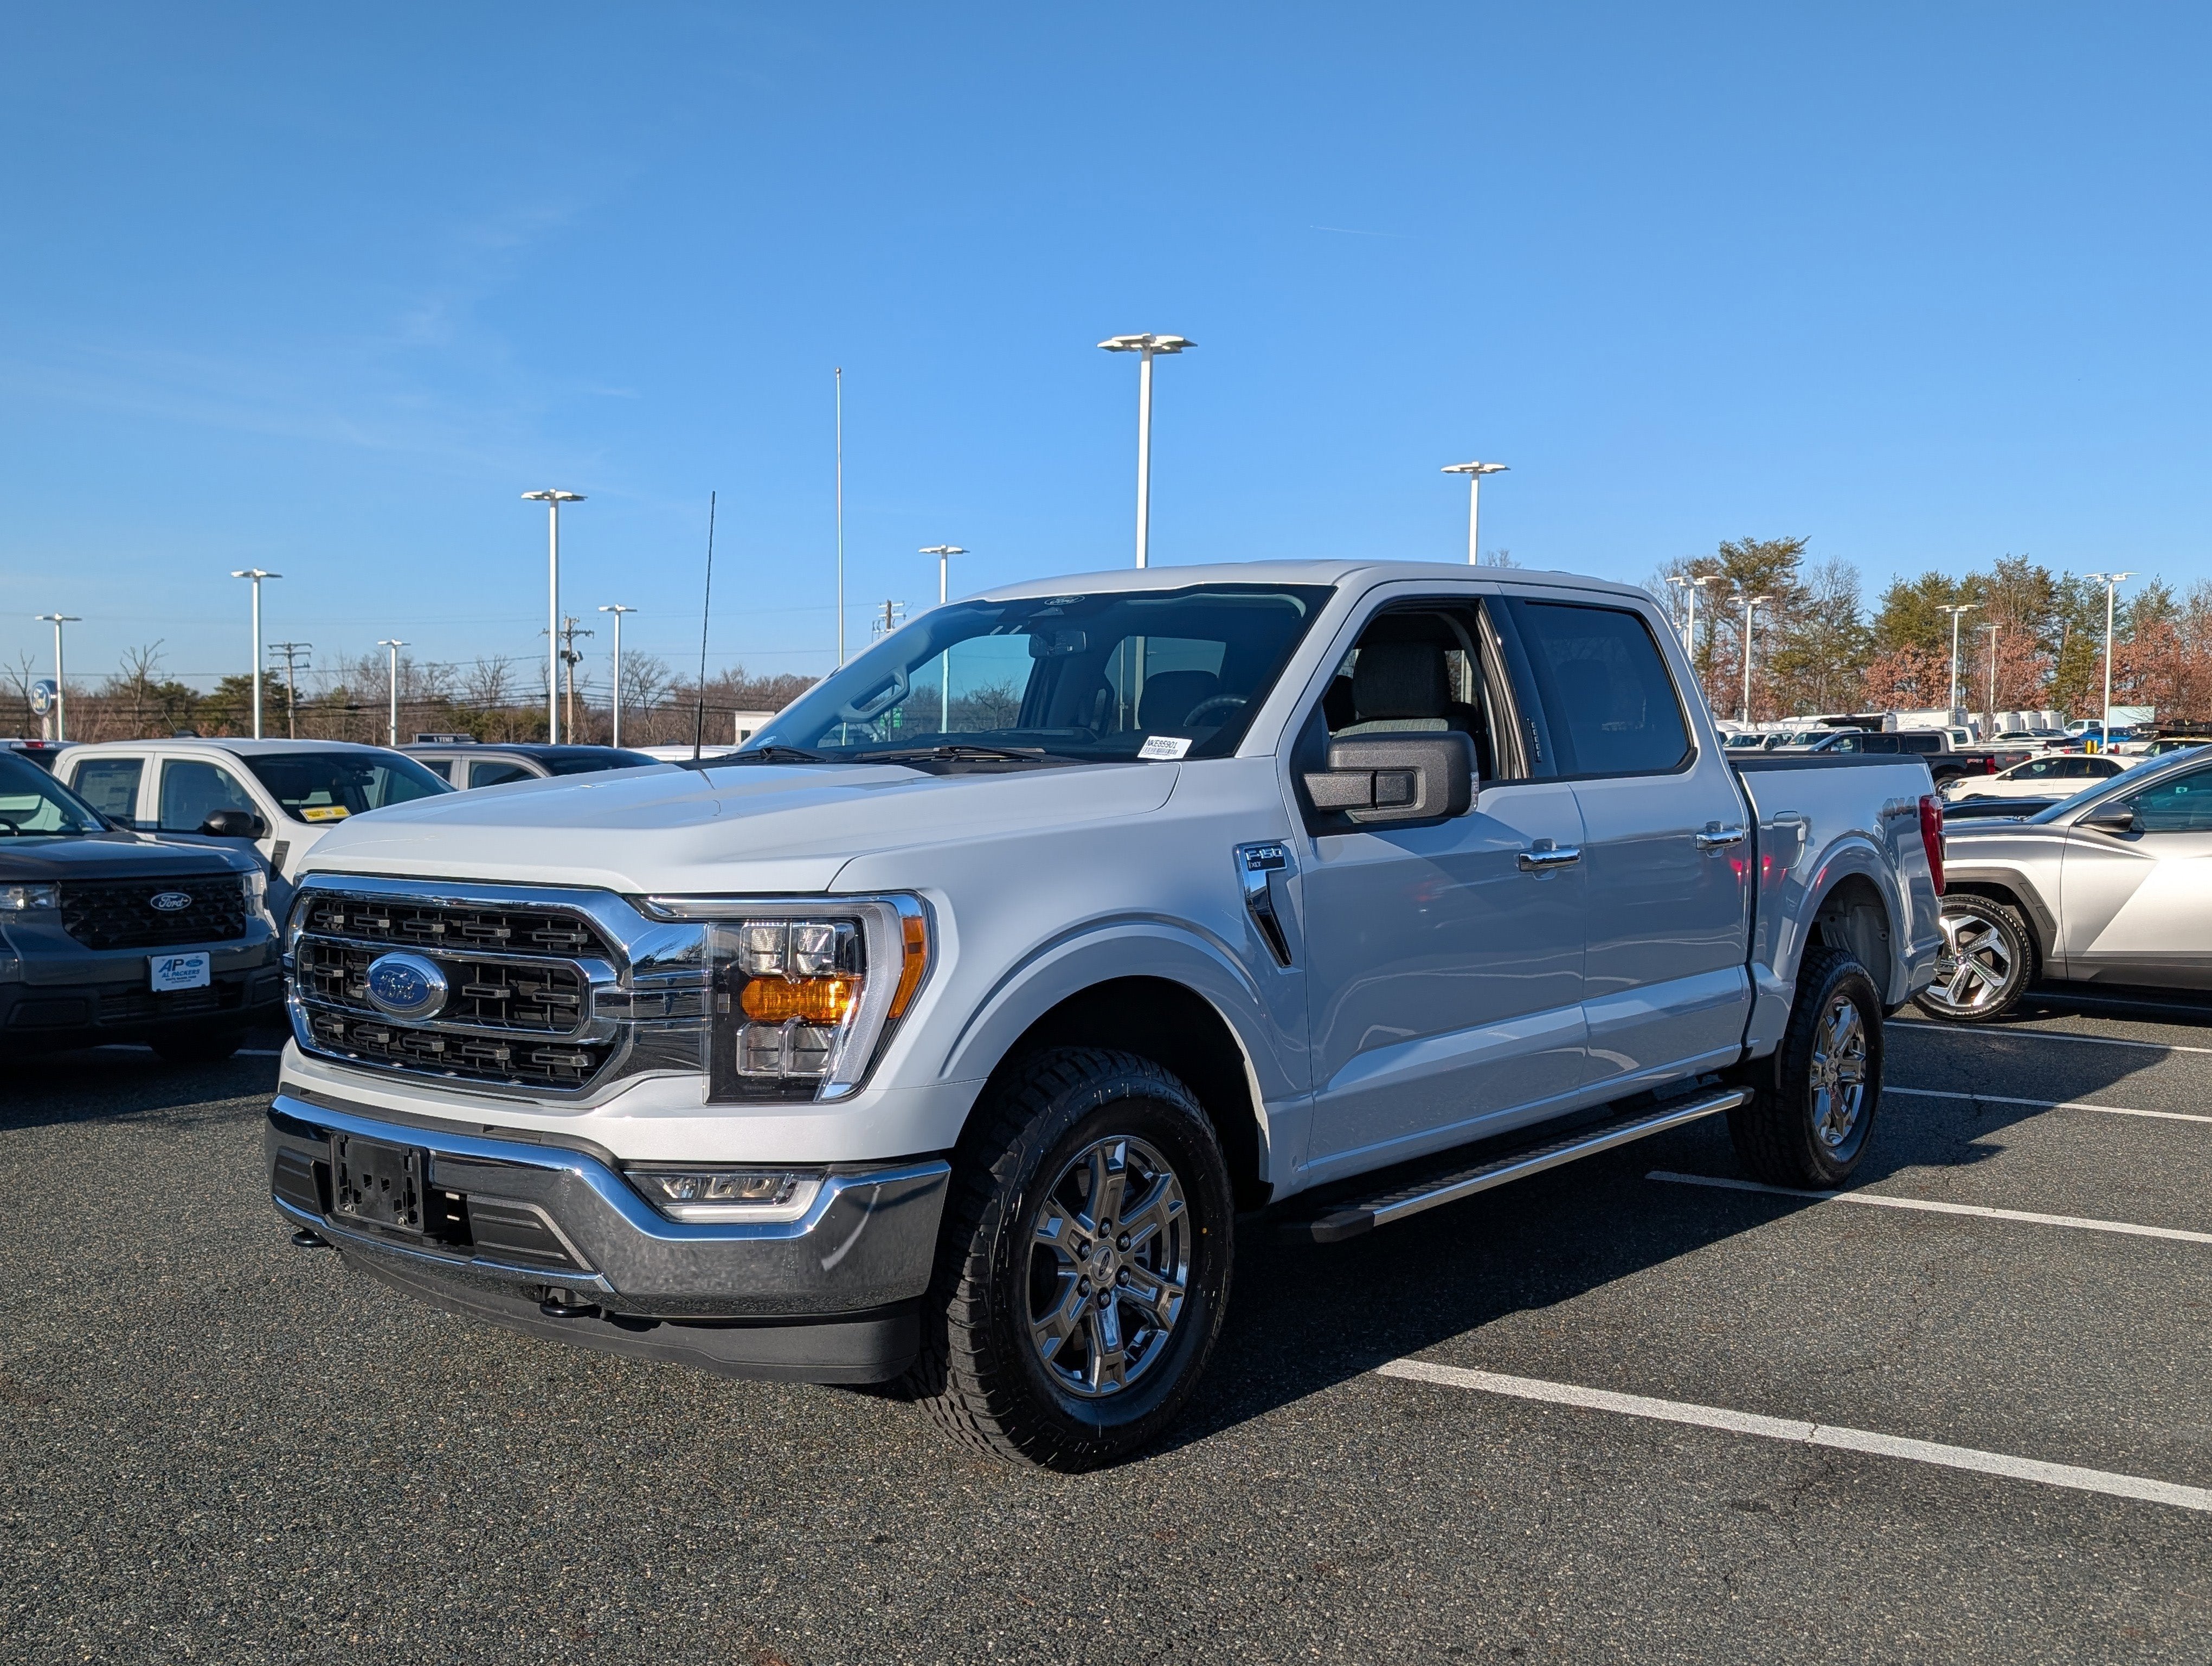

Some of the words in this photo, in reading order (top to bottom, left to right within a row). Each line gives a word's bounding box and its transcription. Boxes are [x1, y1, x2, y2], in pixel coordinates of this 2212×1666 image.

[1245, 848, 1283, 861] F-150
[158, 895, 188, 908] Ford
[158, 959, 184, 972] AP
[378, 970, 416, 1000] Ford
